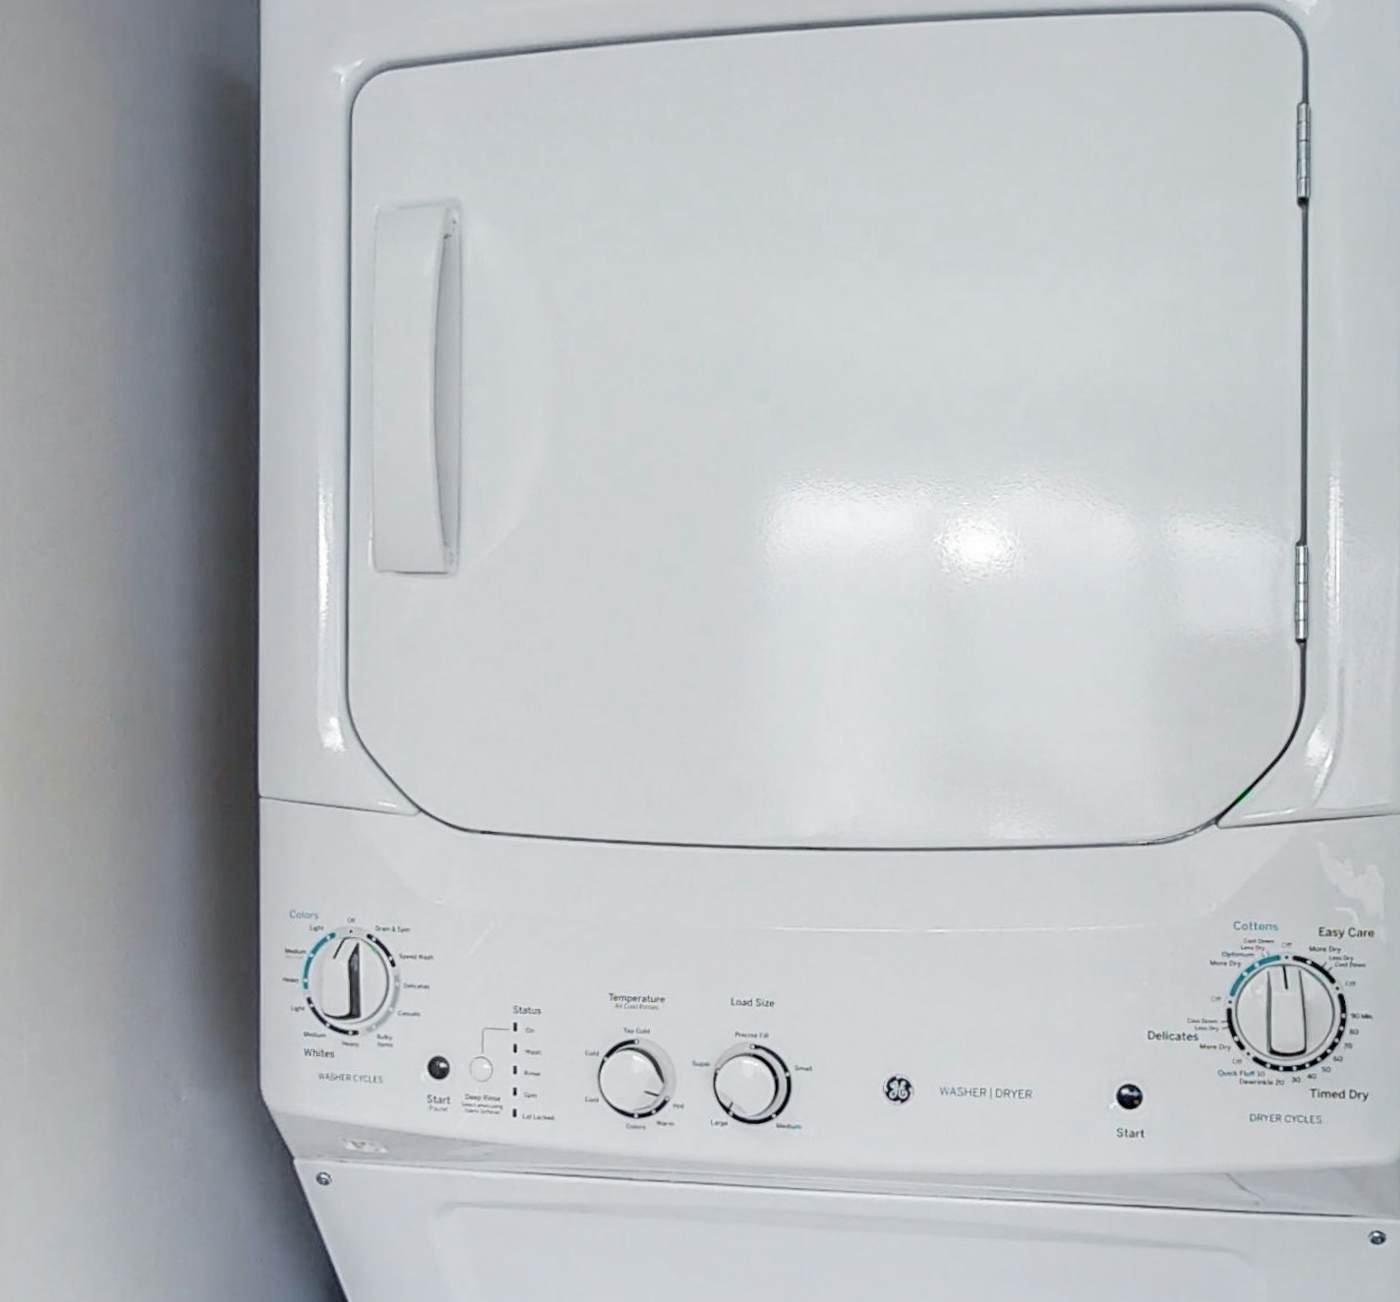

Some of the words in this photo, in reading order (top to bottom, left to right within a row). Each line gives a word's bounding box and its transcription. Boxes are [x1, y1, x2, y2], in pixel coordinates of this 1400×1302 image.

[289, 910, 319, 920] Colors
[1233, 920, 1279, 932] Cottons
[1318, 926, 1345, 939] Easy
[1347, 926, 1376, 938] Care
[608, 992, 667, 1004] Temperature
[730, 997, 754, 1009] Load
[755, 998, 776, 1009] Size
[512, 1004, 542, 1016] Status
[1147, 1029, 1200, 1042] Delicates
[303, 1047, 336, 1059] Whites
[939, 1086, 987, 1098] WASHER
[995, 1088, 1033, 1100] DRYER
[1309, 1088, 1346, 1100] Timed
[1348, 1089, 1369, 1102] Dry
[426, 1094, 451, 1106] Start
[1249, 1113, 1282, 1123] DRYER
[1283, 1114, 1323, 1125] CYCLES
[1116, 1127, 1146, 1139] Start
